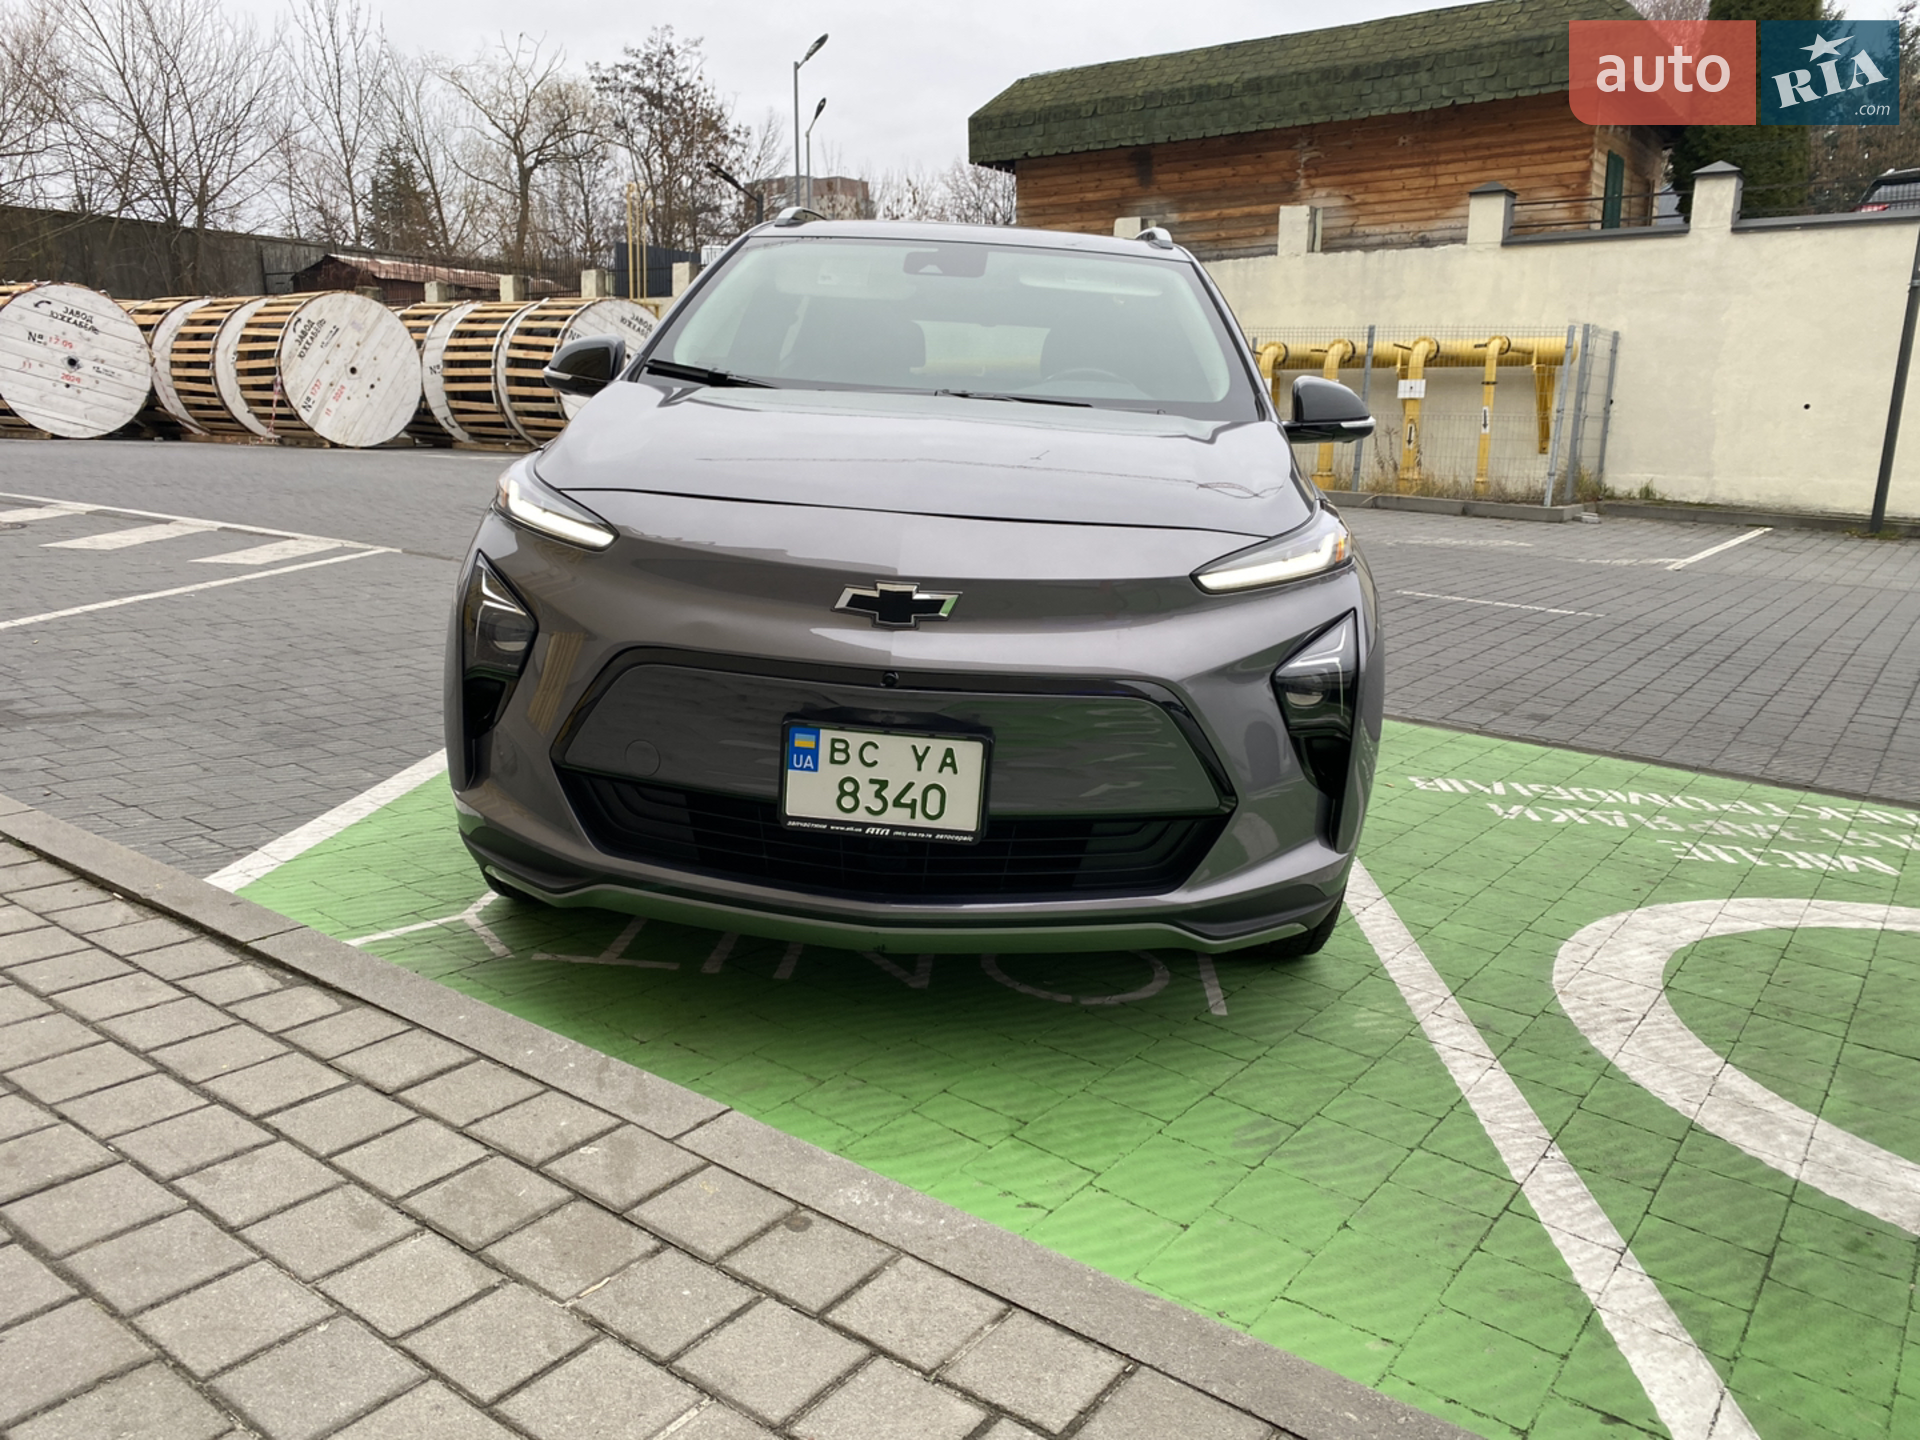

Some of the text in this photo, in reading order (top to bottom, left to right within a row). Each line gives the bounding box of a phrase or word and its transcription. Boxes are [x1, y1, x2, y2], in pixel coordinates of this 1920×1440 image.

[62, 306, 94, 324] ЗАВОД
[792, 753, 815, 770] UA
[836, 776, 947, 821] 8340
[1407, 775, 1920, 826] ЛЕКТРОМОБІЛІВ
